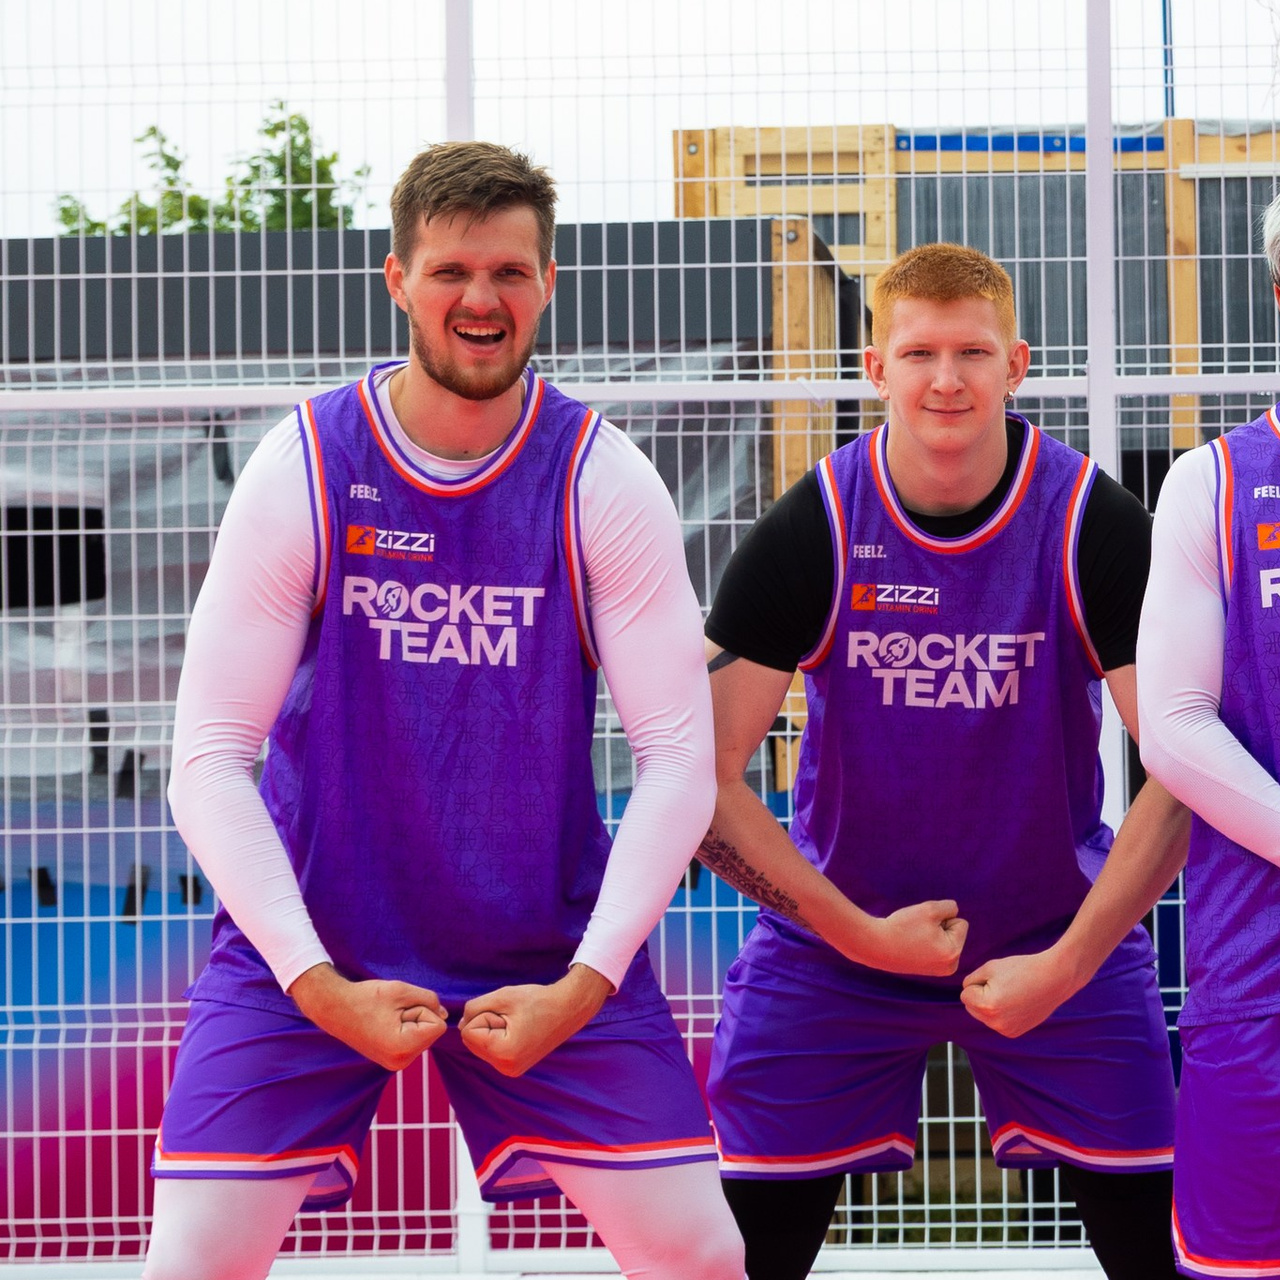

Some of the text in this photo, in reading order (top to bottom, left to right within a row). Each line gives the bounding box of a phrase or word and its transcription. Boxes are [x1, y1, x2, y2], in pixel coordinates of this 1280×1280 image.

[343, 576, 545, 626] ROCKET
[369, 619, 517, 666] TEAM
[848, 631, 1045, 670] ROCKET
[872, 669, 1019, 708] TEAM
